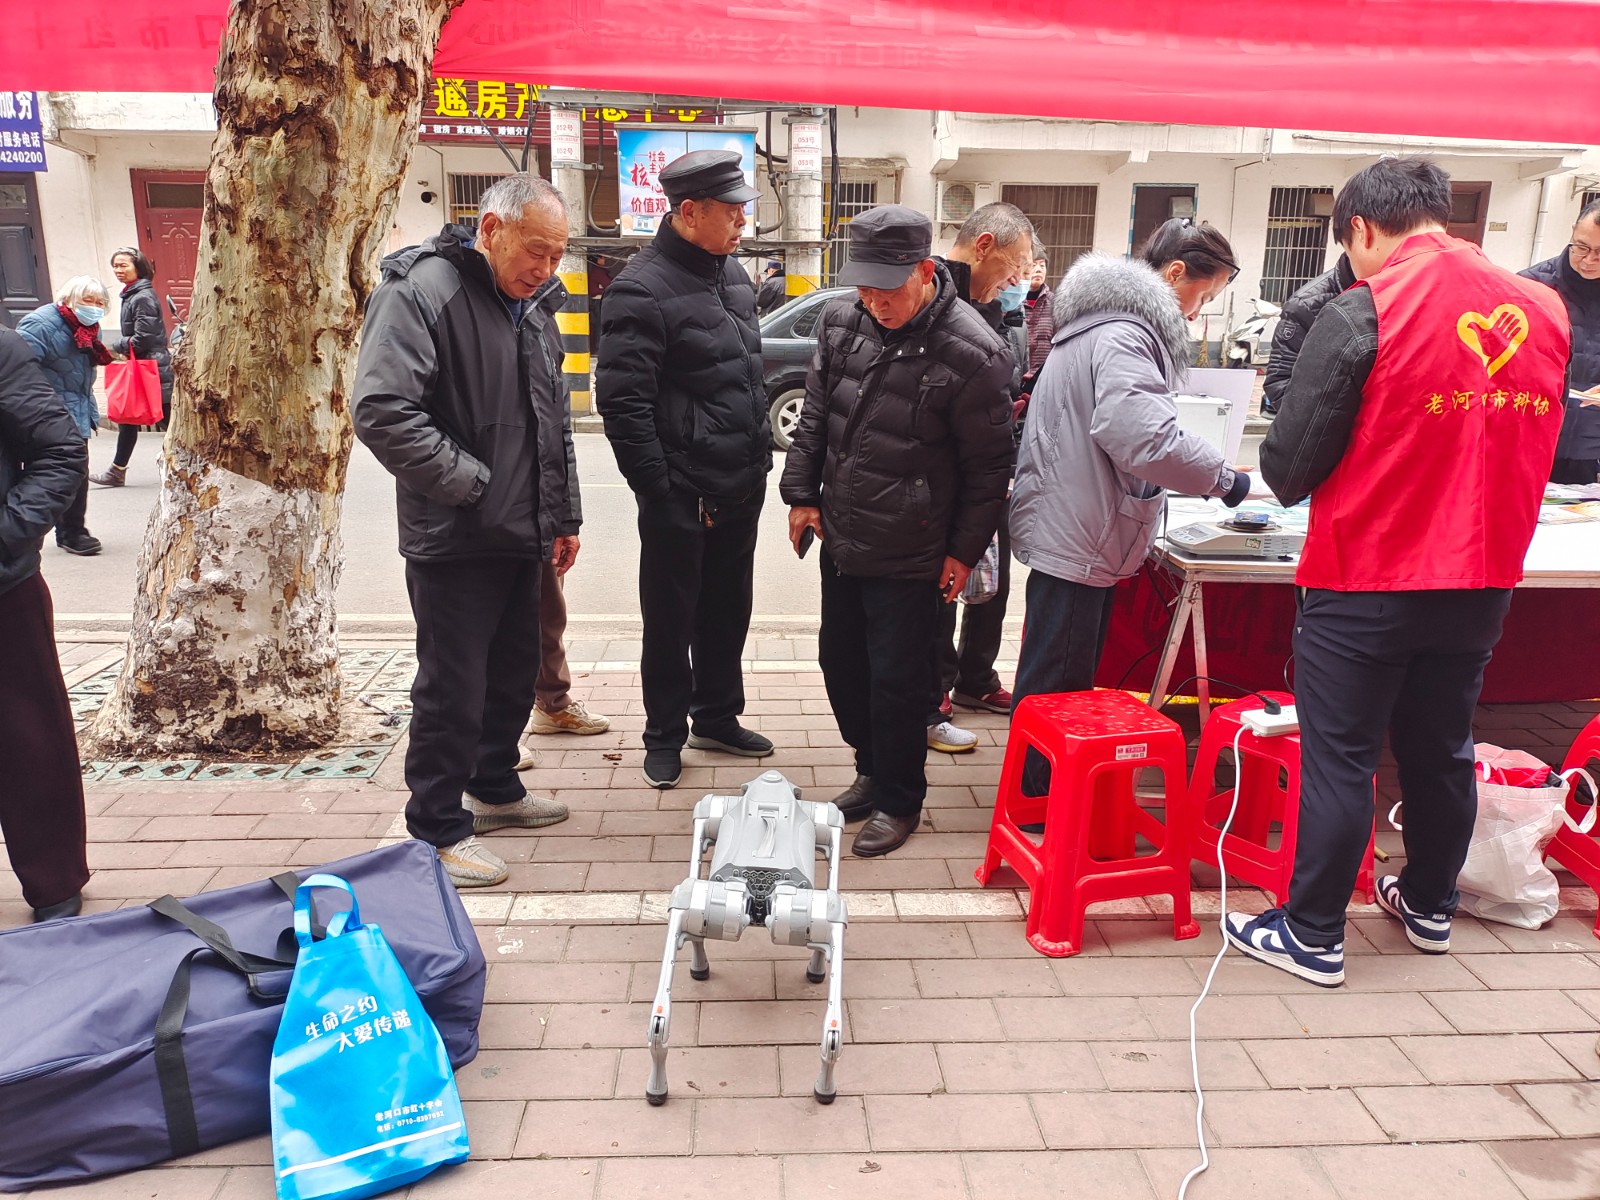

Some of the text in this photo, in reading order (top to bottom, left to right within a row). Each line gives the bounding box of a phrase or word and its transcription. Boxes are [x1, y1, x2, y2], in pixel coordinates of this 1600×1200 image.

[0, 131, 41, 148] 服务电话
[0, 151, 43, 163] 4240200
[648, 150, 666, 162] 社会
[631, 197, 667, 213] 价值观
[306, 995, 379, 1043] 生命之约
[336, 1009, 413, 1053] 大爱传递
